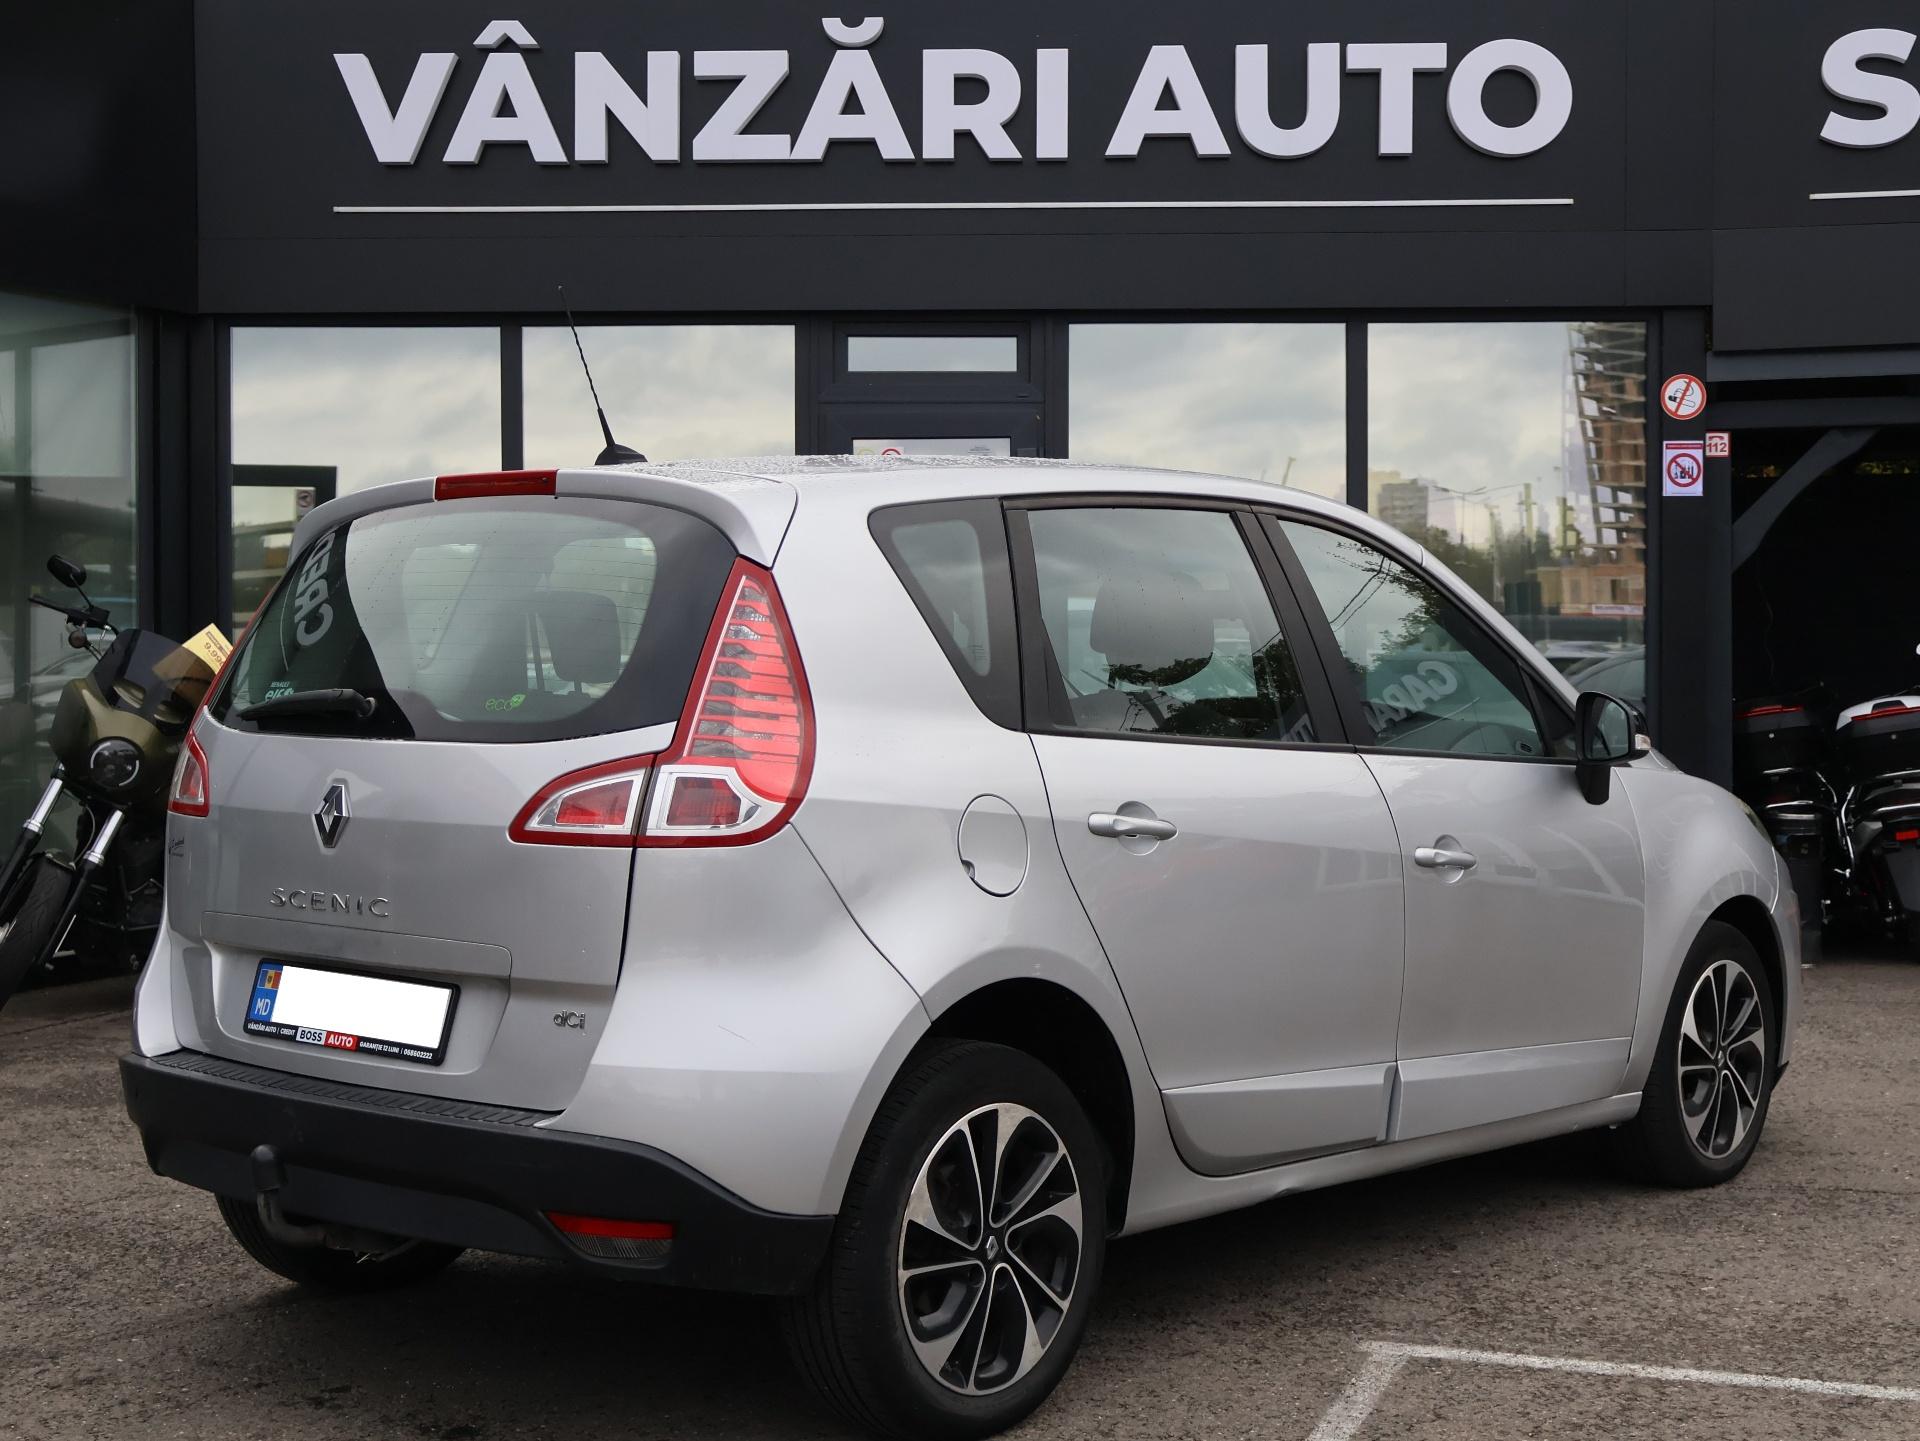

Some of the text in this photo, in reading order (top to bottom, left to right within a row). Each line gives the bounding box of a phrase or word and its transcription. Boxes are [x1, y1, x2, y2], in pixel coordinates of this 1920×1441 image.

[333, 17, 1574, 165] VÂNZĂRI AUTO
[1819, 27, 1920, 149] S
[1706, 442, 1727, 453] 112
[270, 887, 389, 917] SCENIC
[255, 998, 271, 1016] MD
[553, 1009, 585, 1030] dCi
[299, 1029, 323, 1042] BOSS
[327, 1034, 354, 1047] AUTO
